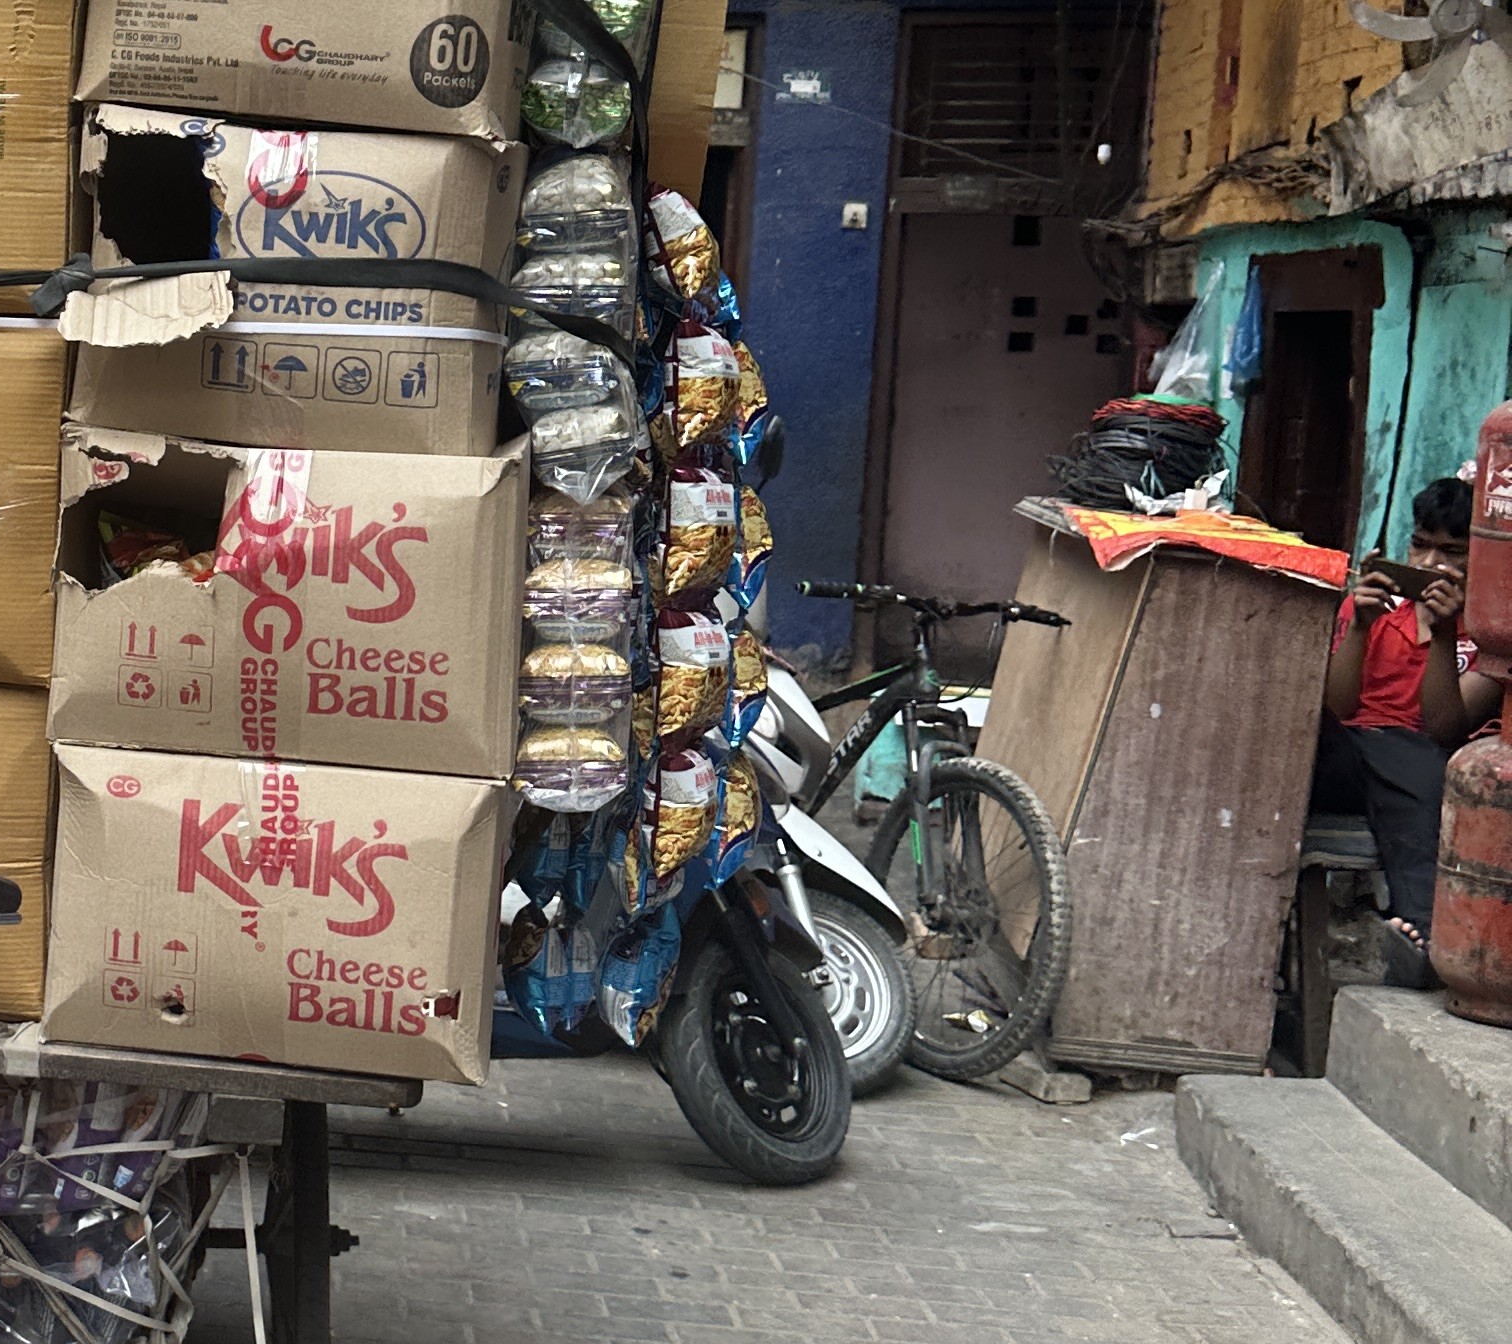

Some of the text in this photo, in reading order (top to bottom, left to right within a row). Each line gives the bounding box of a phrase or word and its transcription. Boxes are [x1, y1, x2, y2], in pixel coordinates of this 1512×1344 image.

[124, 31, 139, 42] ISO
[273, 37, 387, 64] CG CHAUDHARY
[428, 22, 477, 74] 60
[271, 63, 315, 81] Touching
[339, 70, 390, 86] everyday
[316, 58, 356, 68] GROUP
[422, 70, 478, 91] Packets
[235, 290, 424, 324] POTATO CHIPS
[305, 636, 450, 677] Cheese
[240, 656, 259, 752] GROUP
[306, 671, 450, 724] Balls
[108, 778, 140, 794] CG
[177, 798, 409, 937] Kwik's
[287, 947, 428, 991] Cheese
[288, 981, 427, 1037] Balls
